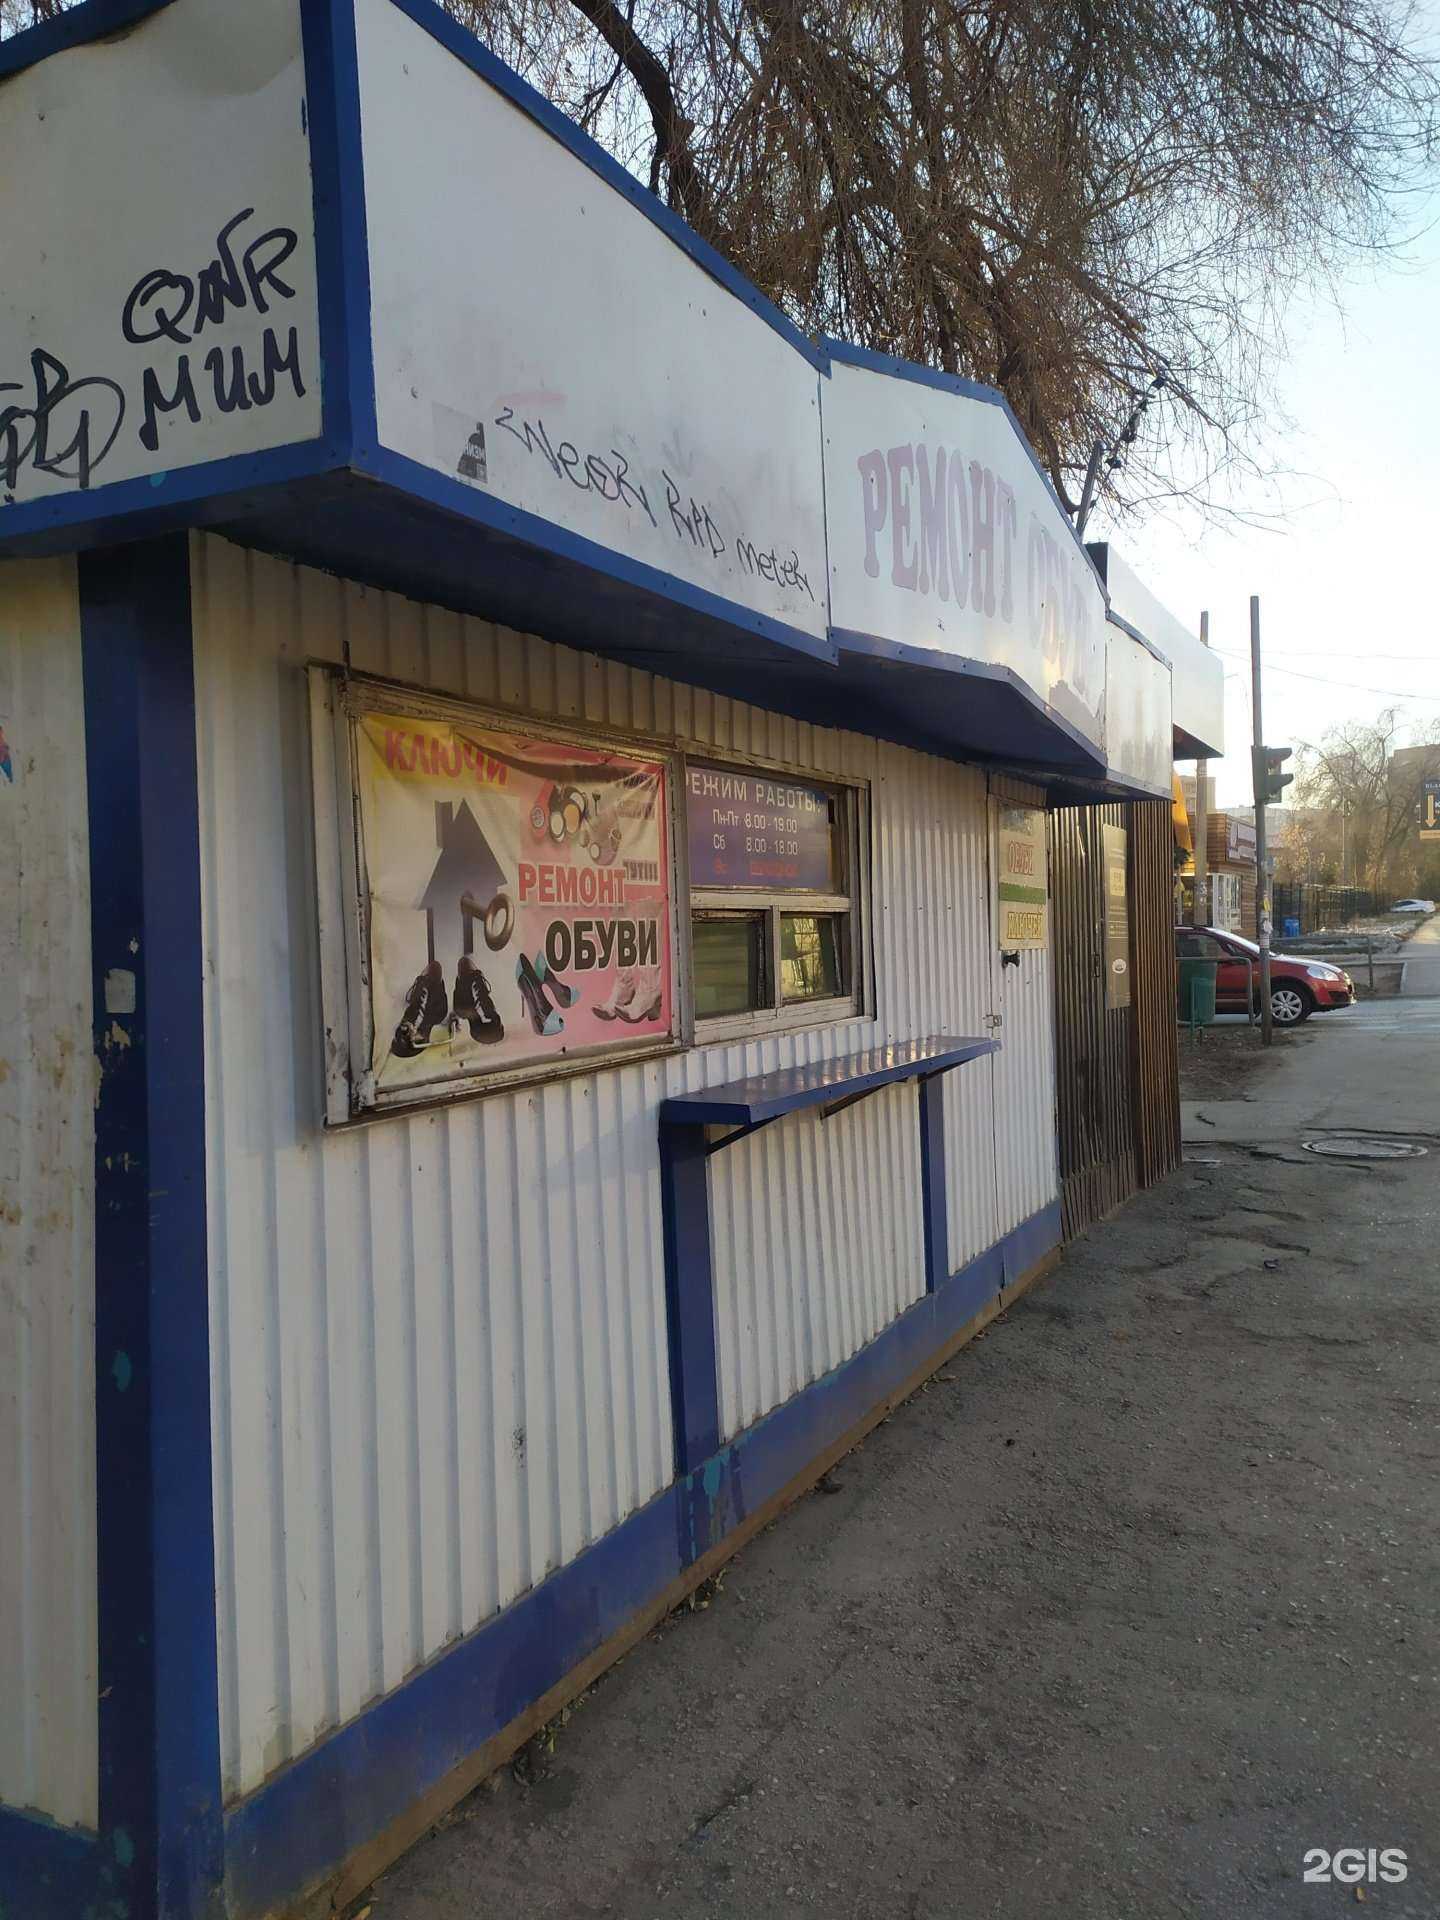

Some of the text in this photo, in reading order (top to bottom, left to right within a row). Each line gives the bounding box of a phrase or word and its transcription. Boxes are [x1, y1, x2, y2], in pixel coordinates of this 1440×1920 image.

[857, 443, 1017, 623] РЕМОНТ
[384, 727, 509, 786] КЛЮЧИ
[518, 862, 626, 907] РЕМОНТ
[545, 919, 659, 973] ОБУВИ
